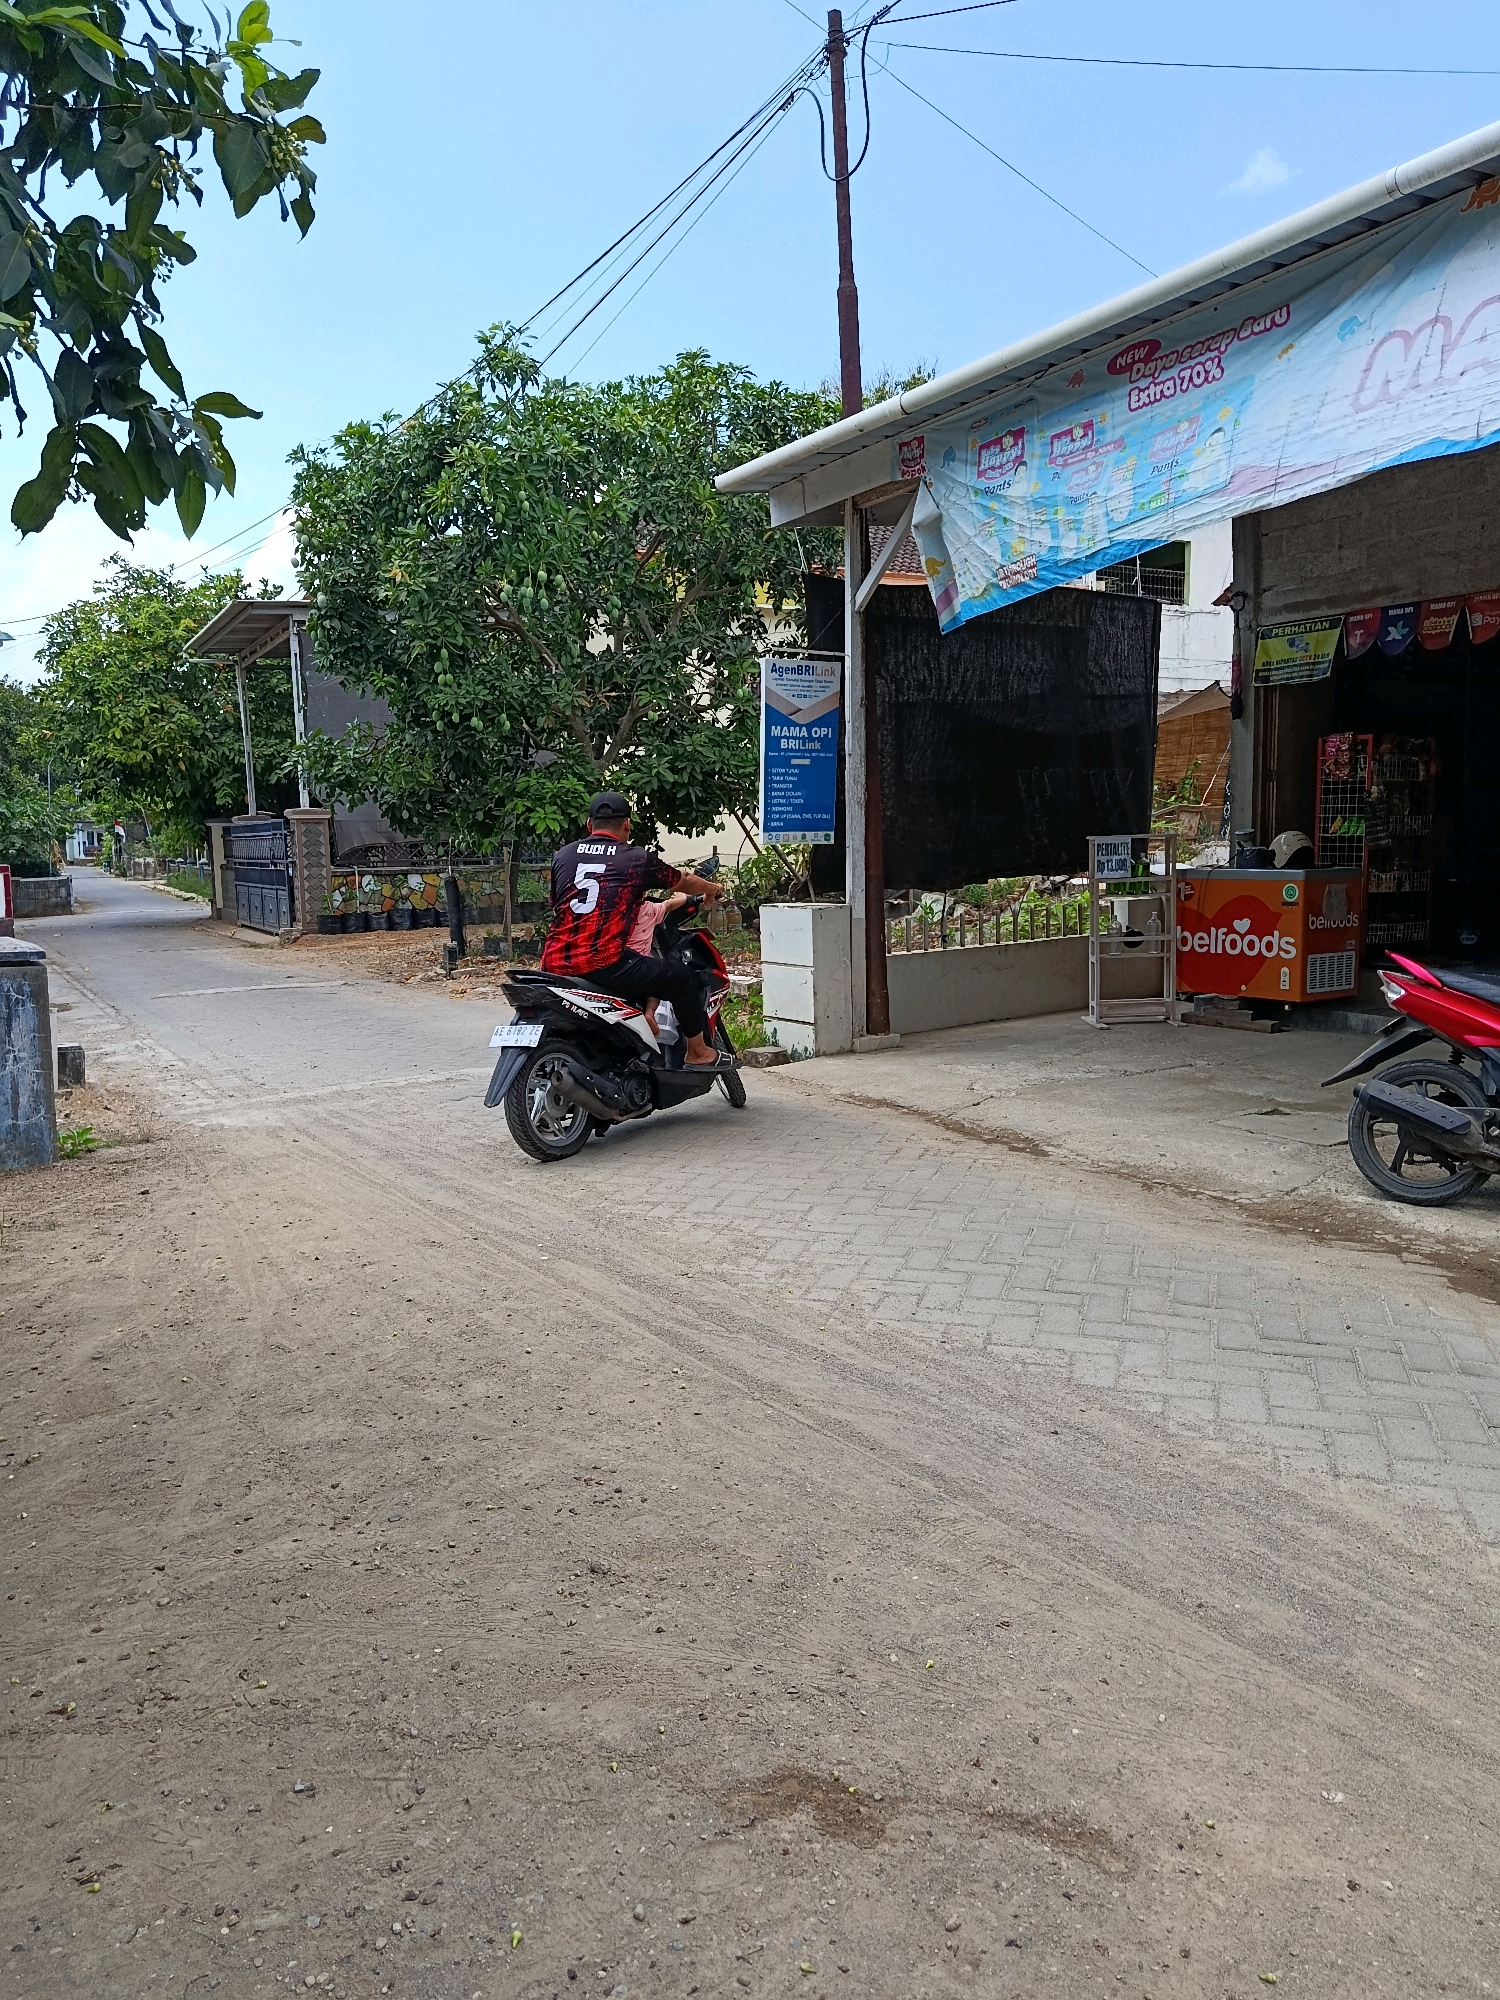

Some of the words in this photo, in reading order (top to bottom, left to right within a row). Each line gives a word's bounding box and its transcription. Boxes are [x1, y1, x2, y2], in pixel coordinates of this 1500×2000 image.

[1130, 351, 1178, 382] Daya
[1180, 329, 1236, 353] serap
[1238, 304, 1290, 340] Baru
[1116, 346, 1149, 369] NEW
[1130, 379, 1175, 410] Extra
[1179, 357, 1223, 392] 70%
[979, 439, 1022, 471] Happy!
[1150, 458, 1180, 476] Pants
[984, 479, 1012, 498] Pants
[1483, 616, 1500, 625] Pay
[1271, 621, 1330, 637] PERHATIAN
[770, 662, 836, 677] AgenBRILink
[771, 725, 808, 737] MAMA
[812, 727, 832, 738] OPI
[781, 738, 821, 750] BRILink
[577, 843, 605, 855] BUDI
[607, 845, 617, 855] H
[1096, 842, 1130, 857] PERTALITE
[1096, 859, 1105, 874] Rp
[570, 863, 606, 914] 5
[1176, 925, 1297, 959] belfoods
[494, 1026, 505, 1037] AE
[528, 1025, 541, 1036] ZE
